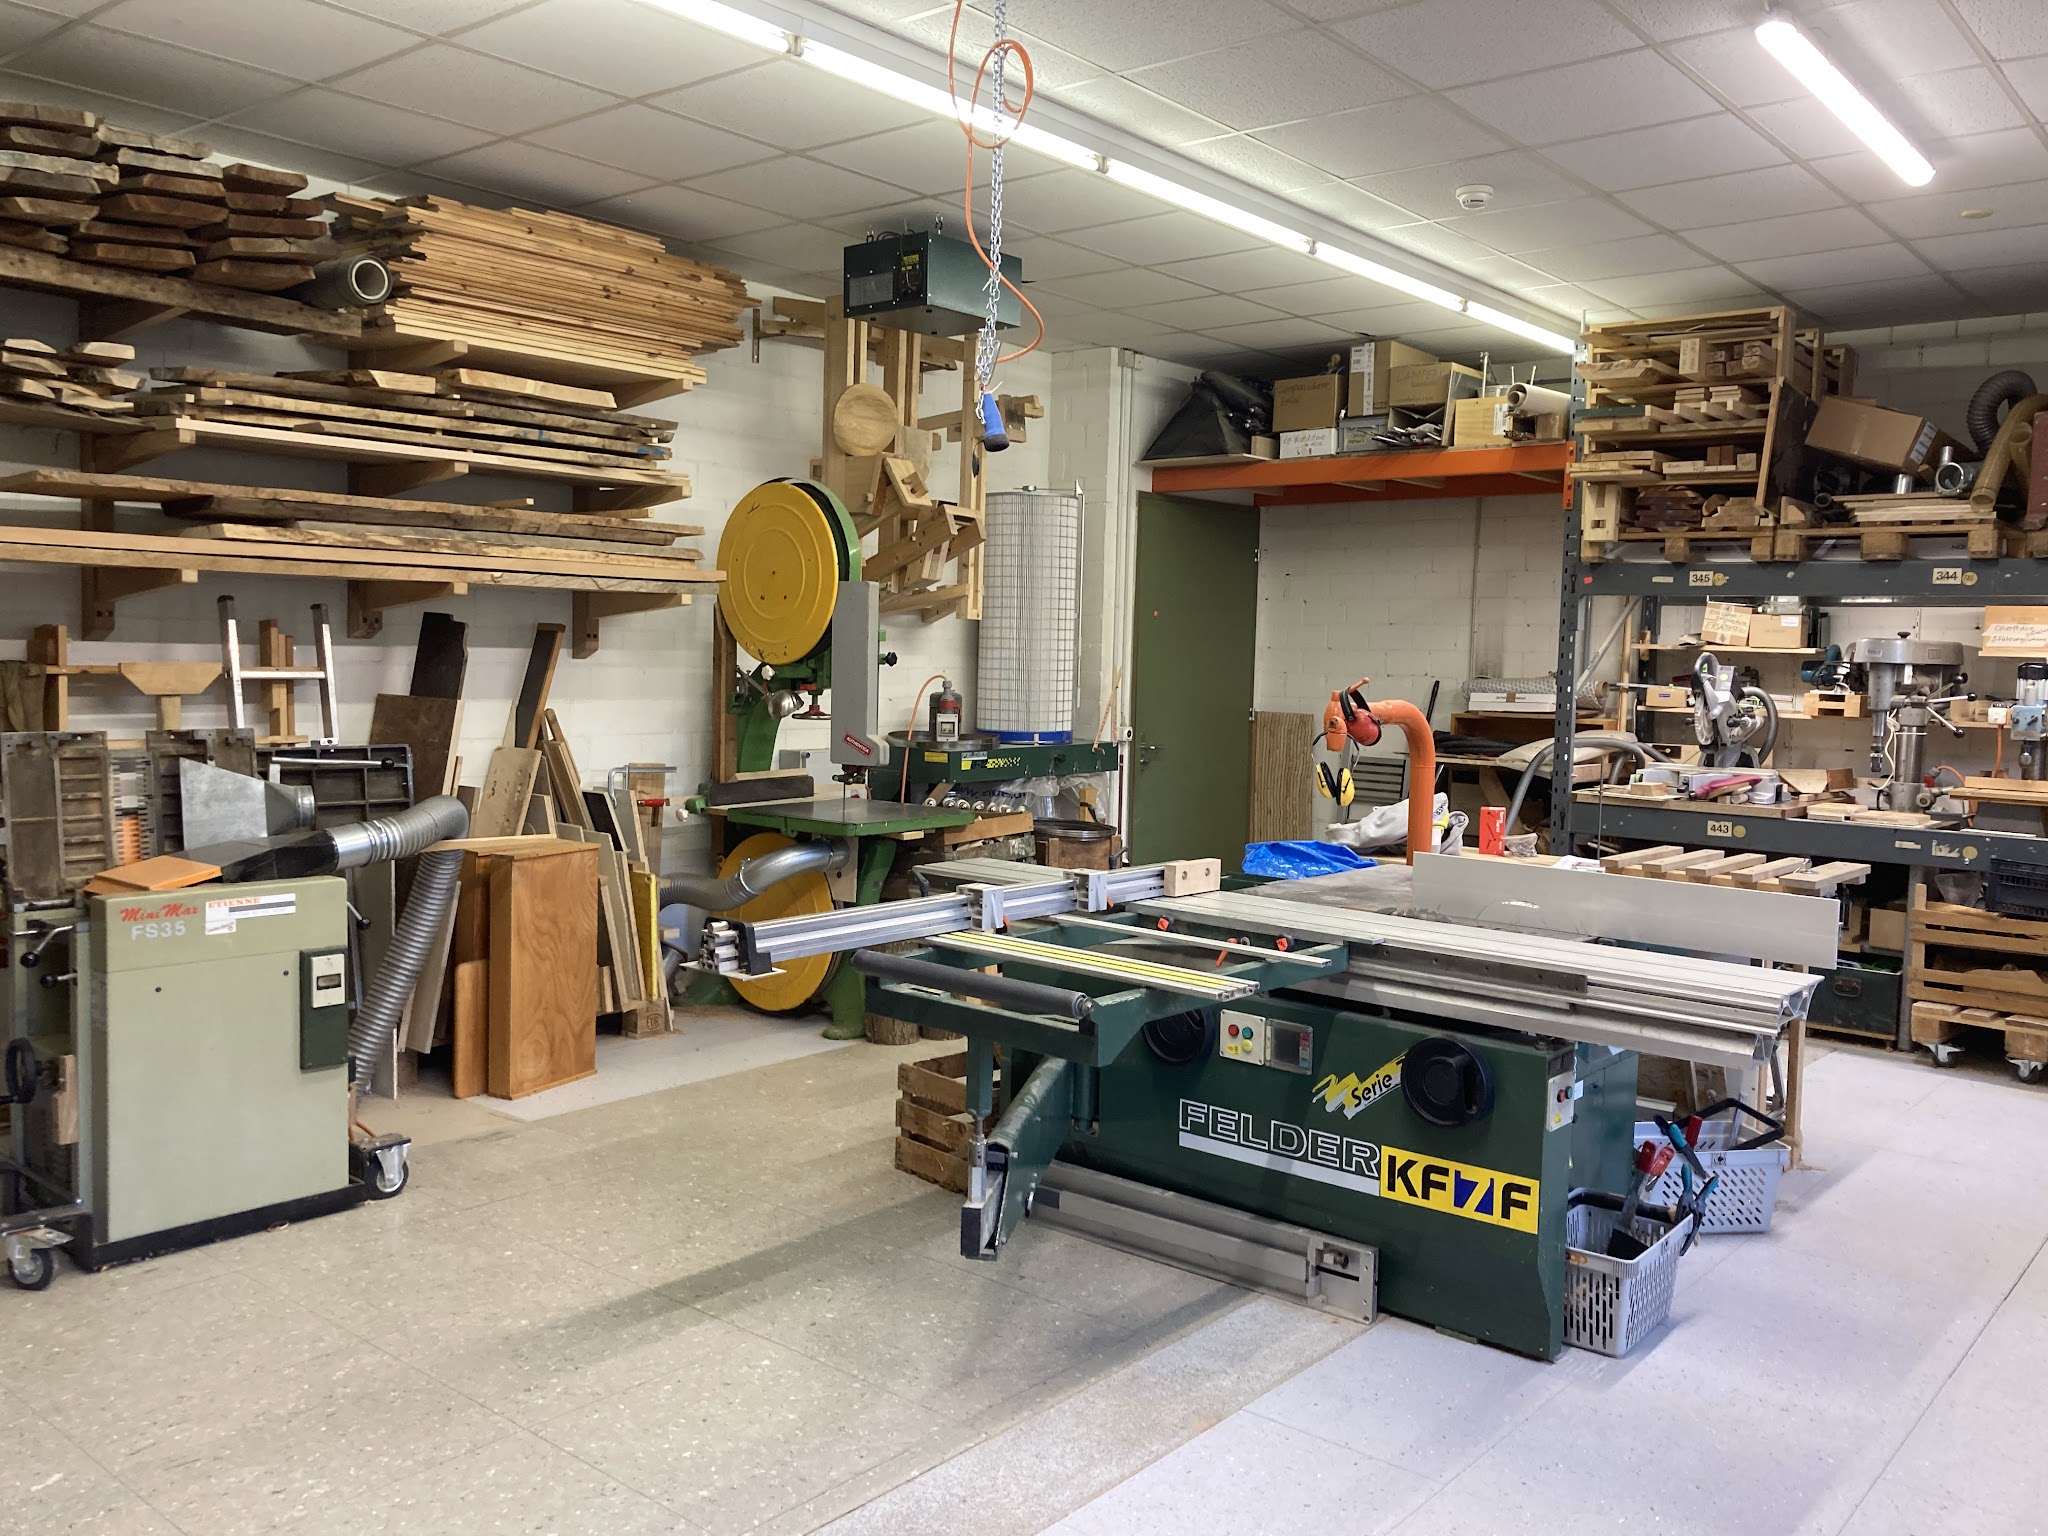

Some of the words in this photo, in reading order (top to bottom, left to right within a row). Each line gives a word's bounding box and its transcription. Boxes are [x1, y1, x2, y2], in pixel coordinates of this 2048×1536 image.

[1692, 573, 1710, 583] 345
[1936, 571, 1958, 581] 344
[1710, 824, 1729, 834] 443
[208, 897, 261, 909] ETIENNE
[131, 920, 186, 941] FS35
[1351, 1073, 1393, 1109] Serie
[1178, 1098, 1380, 1178] FELDER
